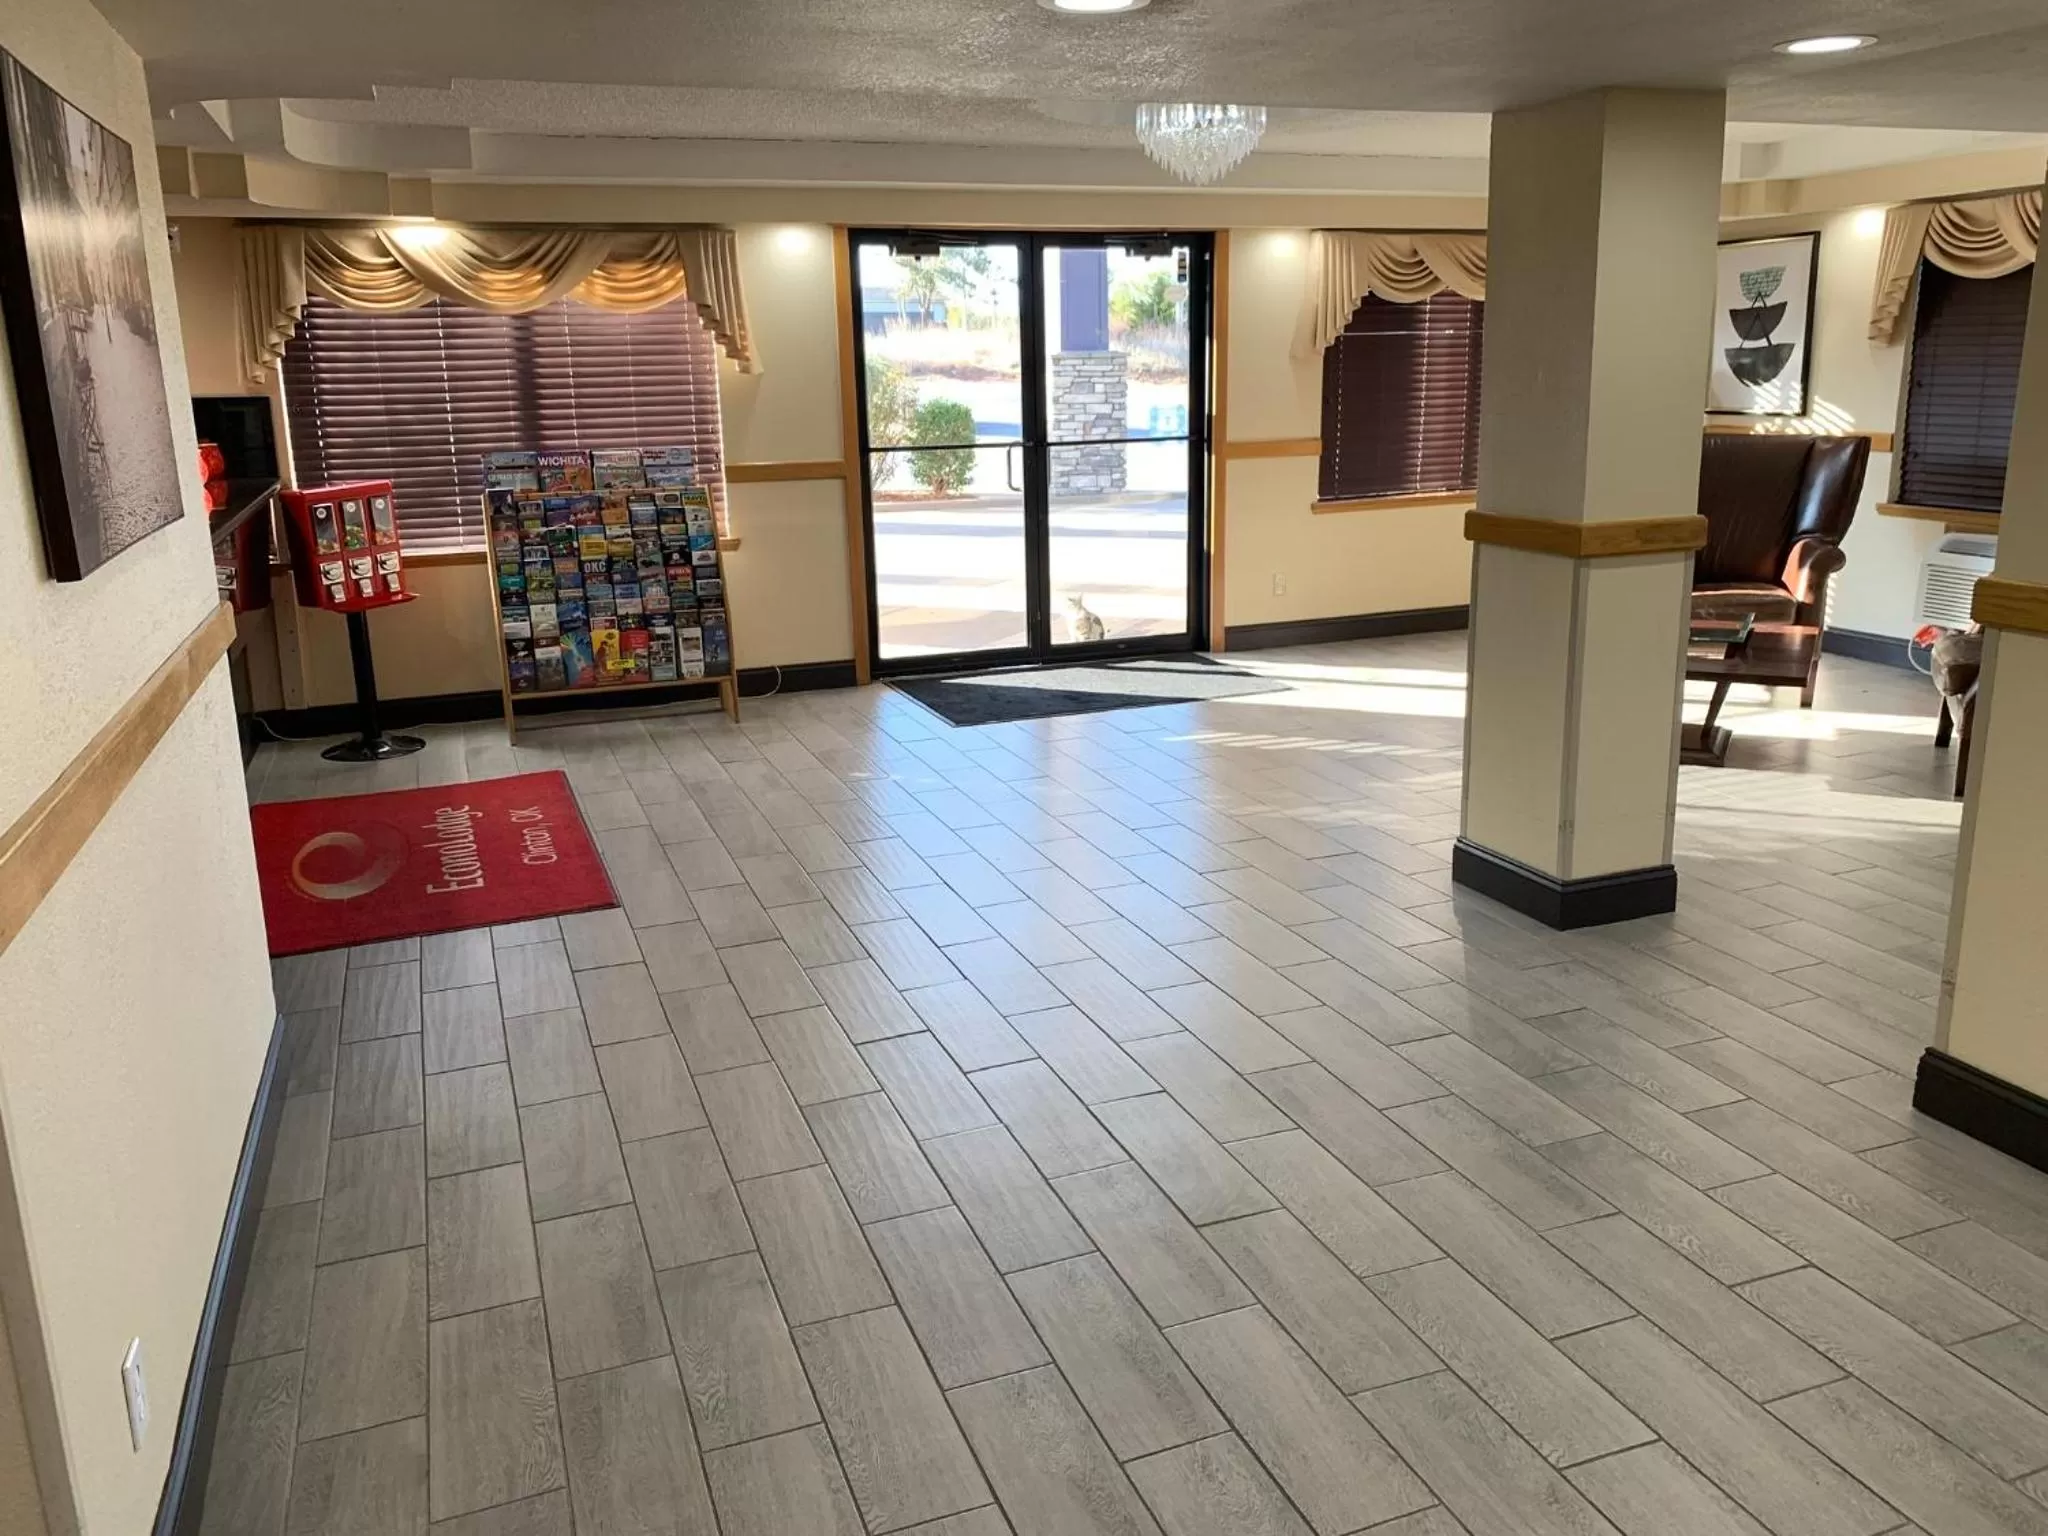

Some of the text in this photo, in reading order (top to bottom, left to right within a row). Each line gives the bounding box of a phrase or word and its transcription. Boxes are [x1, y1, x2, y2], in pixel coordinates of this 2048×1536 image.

[538, 455, 585, 467] WICHITA
[584, 561, 607, 573] OKC
[509, 806, 558, 865] Clinton, OK
